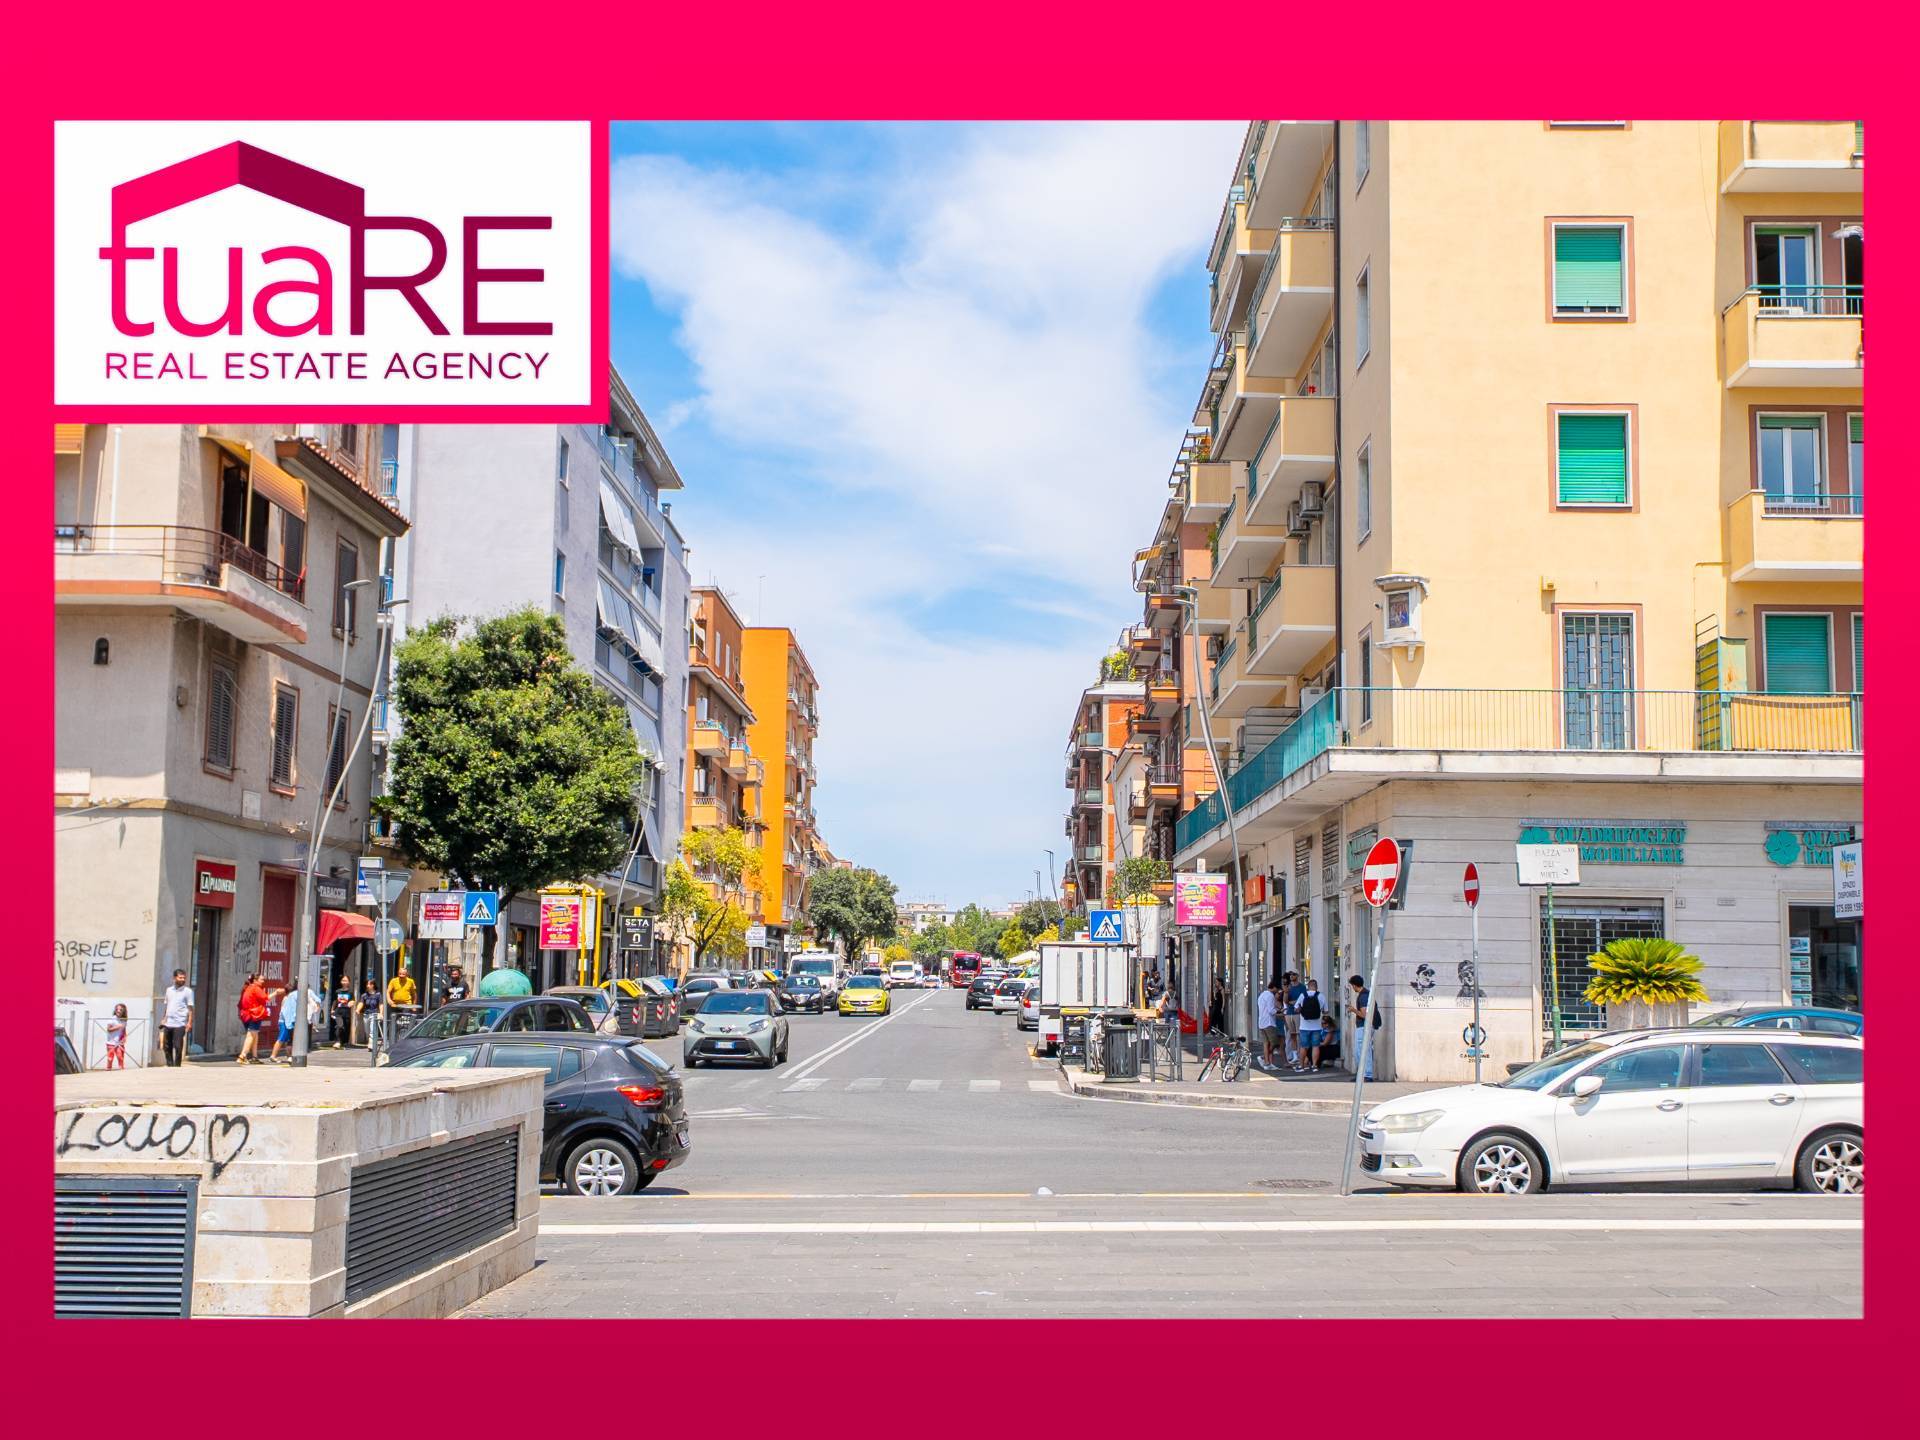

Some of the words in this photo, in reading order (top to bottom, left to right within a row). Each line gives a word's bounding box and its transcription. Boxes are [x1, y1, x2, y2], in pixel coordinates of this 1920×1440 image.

[1555, 827, 1687, 845] QUADRIFOGLIO
[1803, 831, 1851, 847] QUAD
[1535, 849, 1560, 857] PIAZZA
[1580, 846, 1684, 864] MOBILIARE
[201, 873, 209, 890] LA
[320, 885, 347, 899] TABACCHI
[57, 958, 108, 984] VIVE
